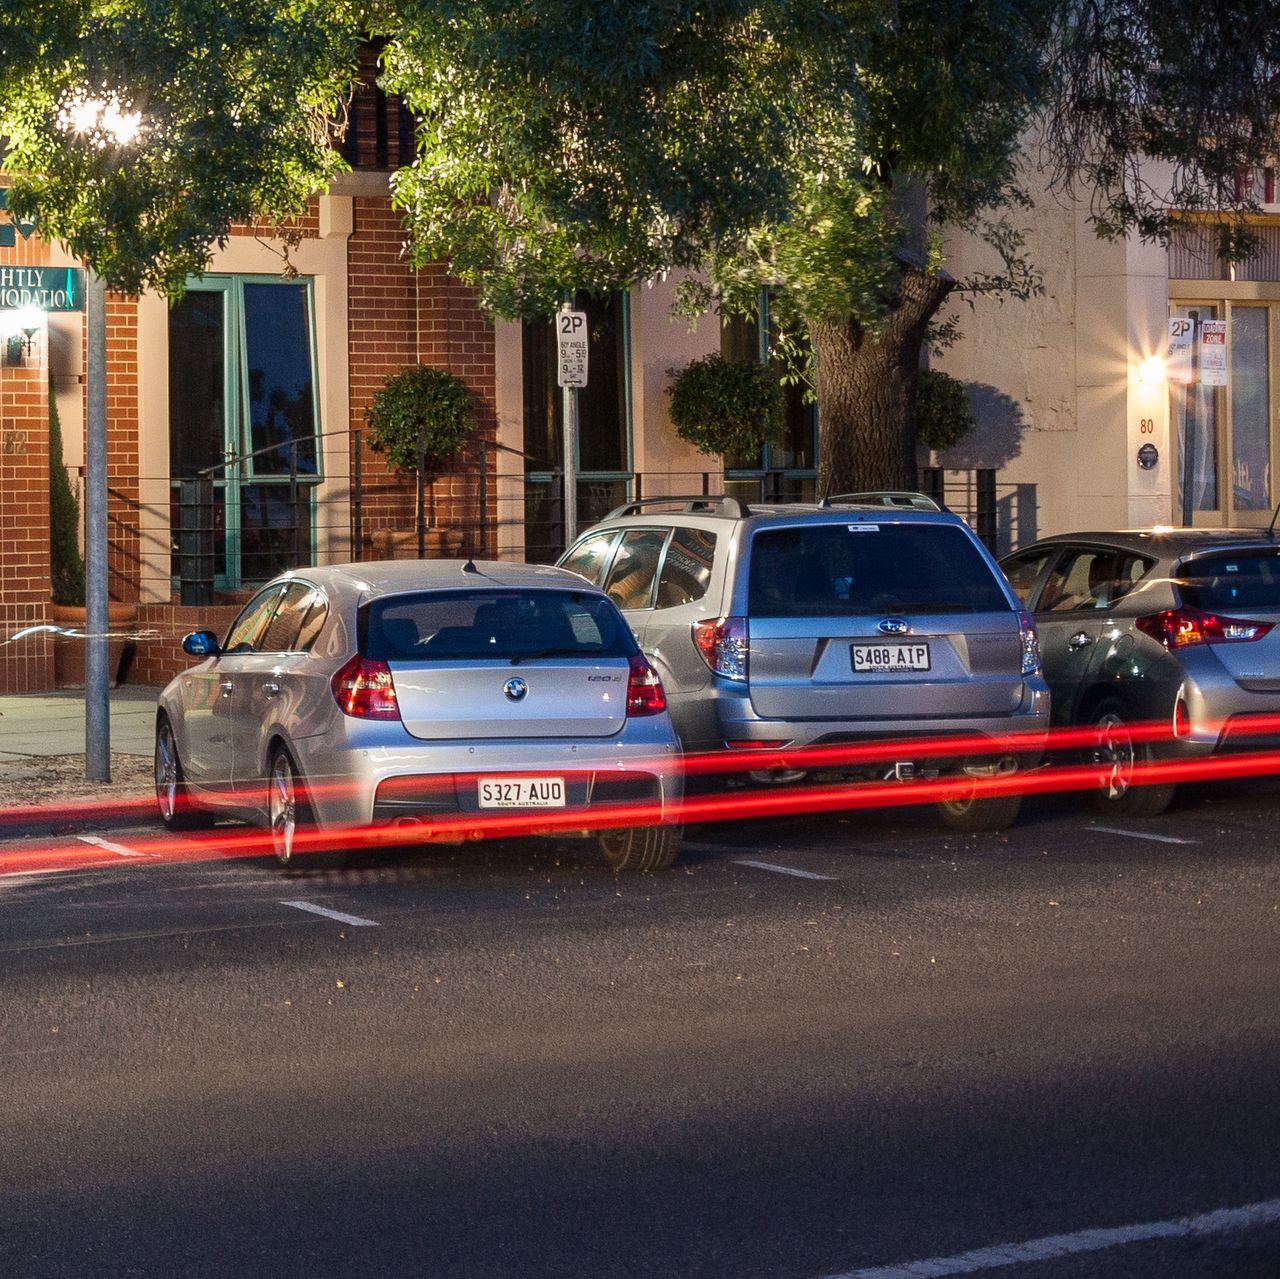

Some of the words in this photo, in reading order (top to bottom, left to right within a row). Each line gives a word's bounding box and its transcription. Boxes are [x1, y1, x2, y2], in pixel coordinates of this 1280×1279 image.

[561, 316, 583, 334] 2P
[1171, 321, 1191, 337] 2P
[1206, 334, 1223, 344] ZONE
[1140, 419, 1154, 434] 80
